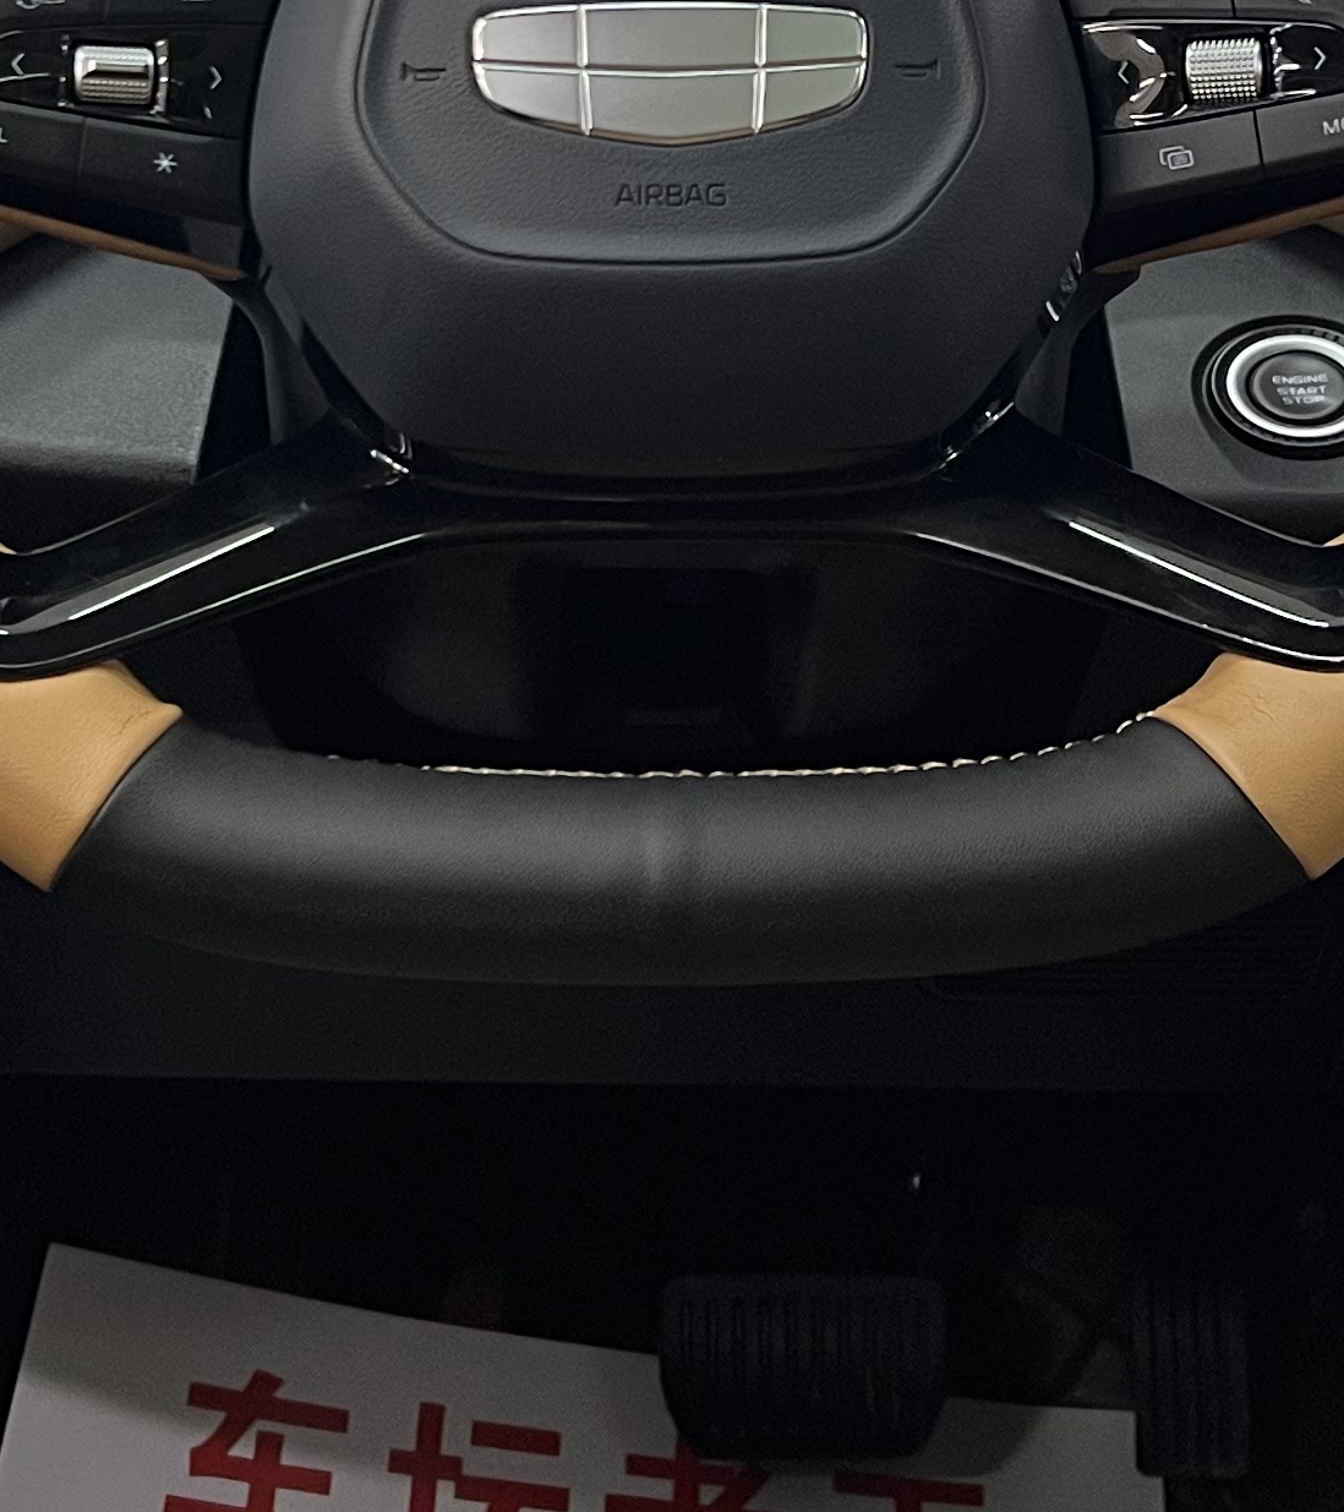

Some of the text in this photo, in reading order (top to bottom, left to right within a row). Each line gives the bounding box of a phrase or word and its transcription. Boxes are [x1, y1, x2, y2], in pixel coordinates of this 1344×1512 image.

[615, 183, 731, 208] AIRBAG
[1272, 373, 1328, 385] ENGINE
[1277, 385, 1327, 396] START
[1282, 395, 1325, 405] STOP
[164, 1367, 987, 1512] 车坛
